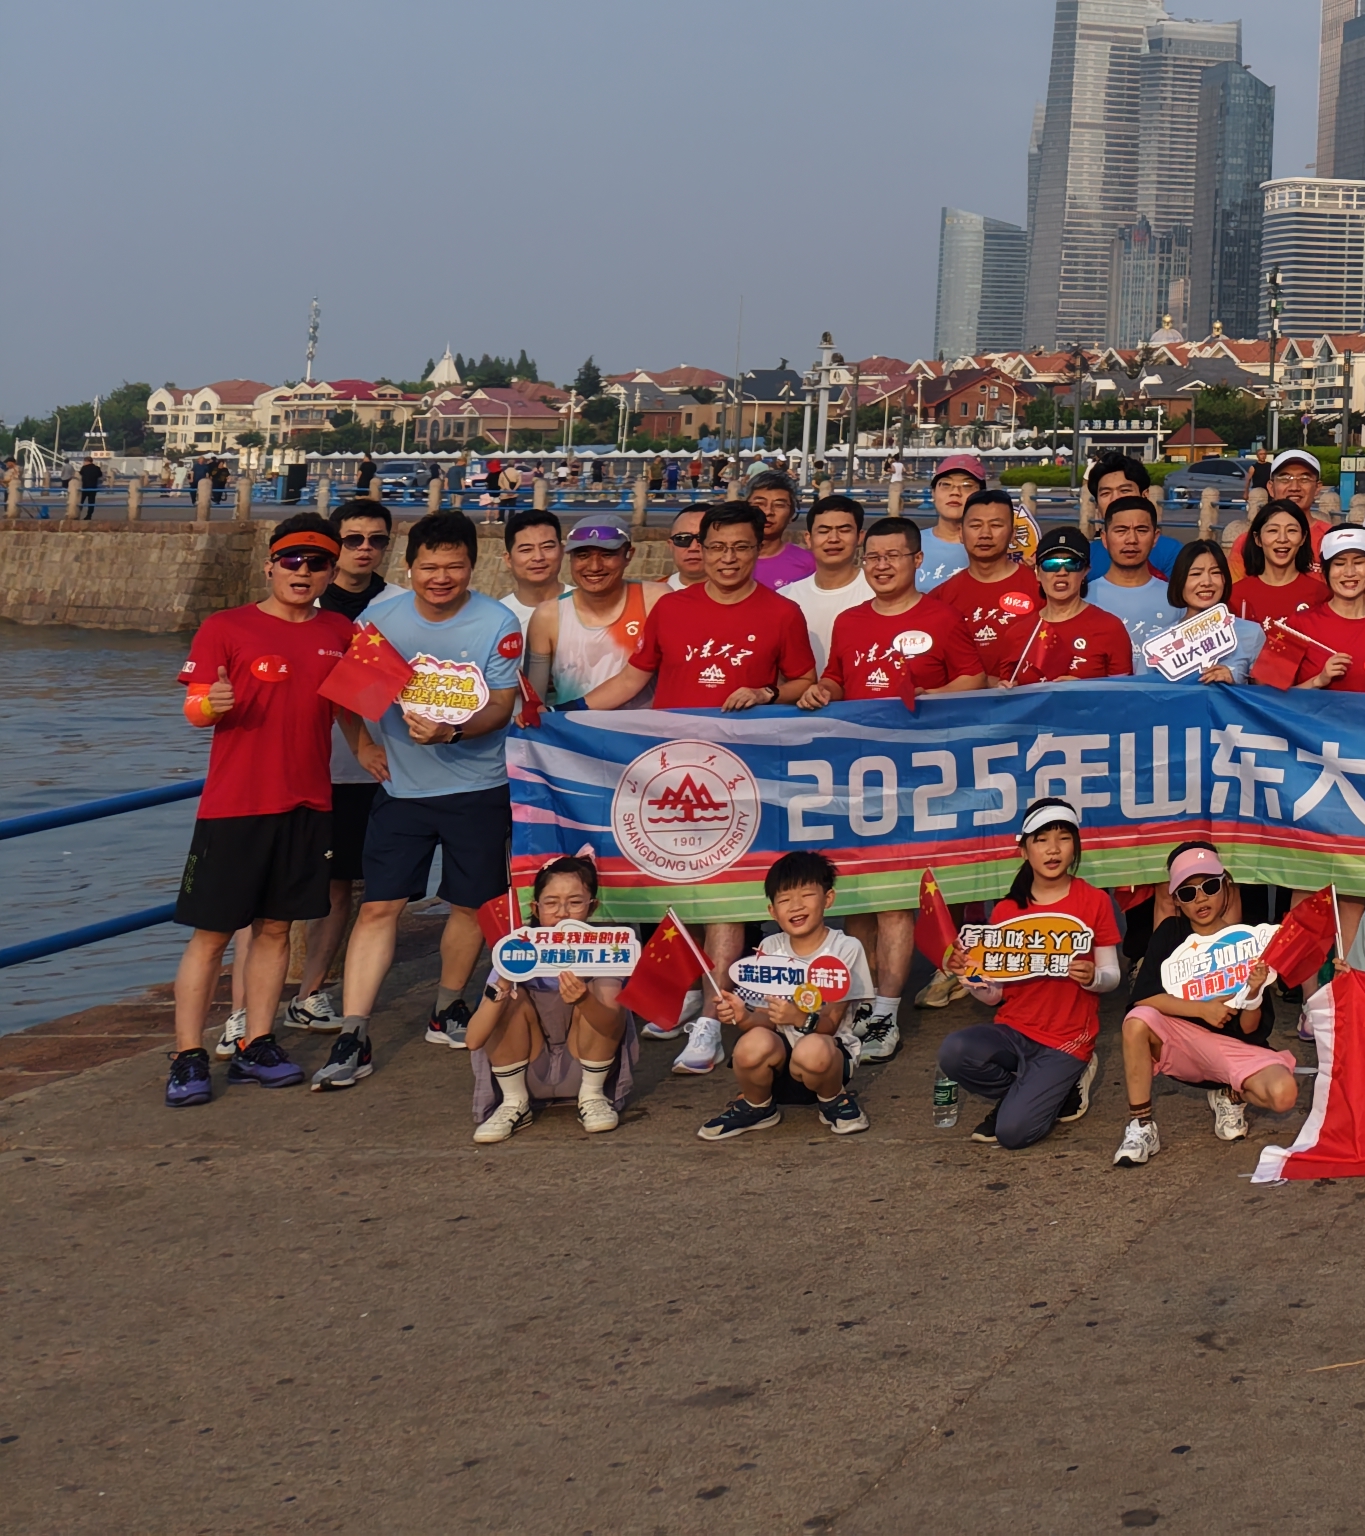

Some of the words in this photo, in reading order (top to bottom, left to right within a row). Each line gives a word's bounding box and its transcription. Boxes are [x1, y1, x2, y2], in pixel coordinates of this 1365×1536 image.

[1172, 631, 1231, 668] 山大健儿
[409, 672, 475, 694] 放弃不难
[622, 812, 687, 872] SHANGDONG
[689, 810, 751, 872] UNIVERSITY
[673, 836, 703, 848] 1901
[534, 930, 630, 945] 只要我跑的快
[960, 927, 1093, 954] 见人不如健身
[540, 948, 631, 964] 就追不上我
[982, 950, 1070, 977] 能量满满
[1167, 935, 1260, 986] 脚步如风
[810, 966, 848, 990] 流汗
